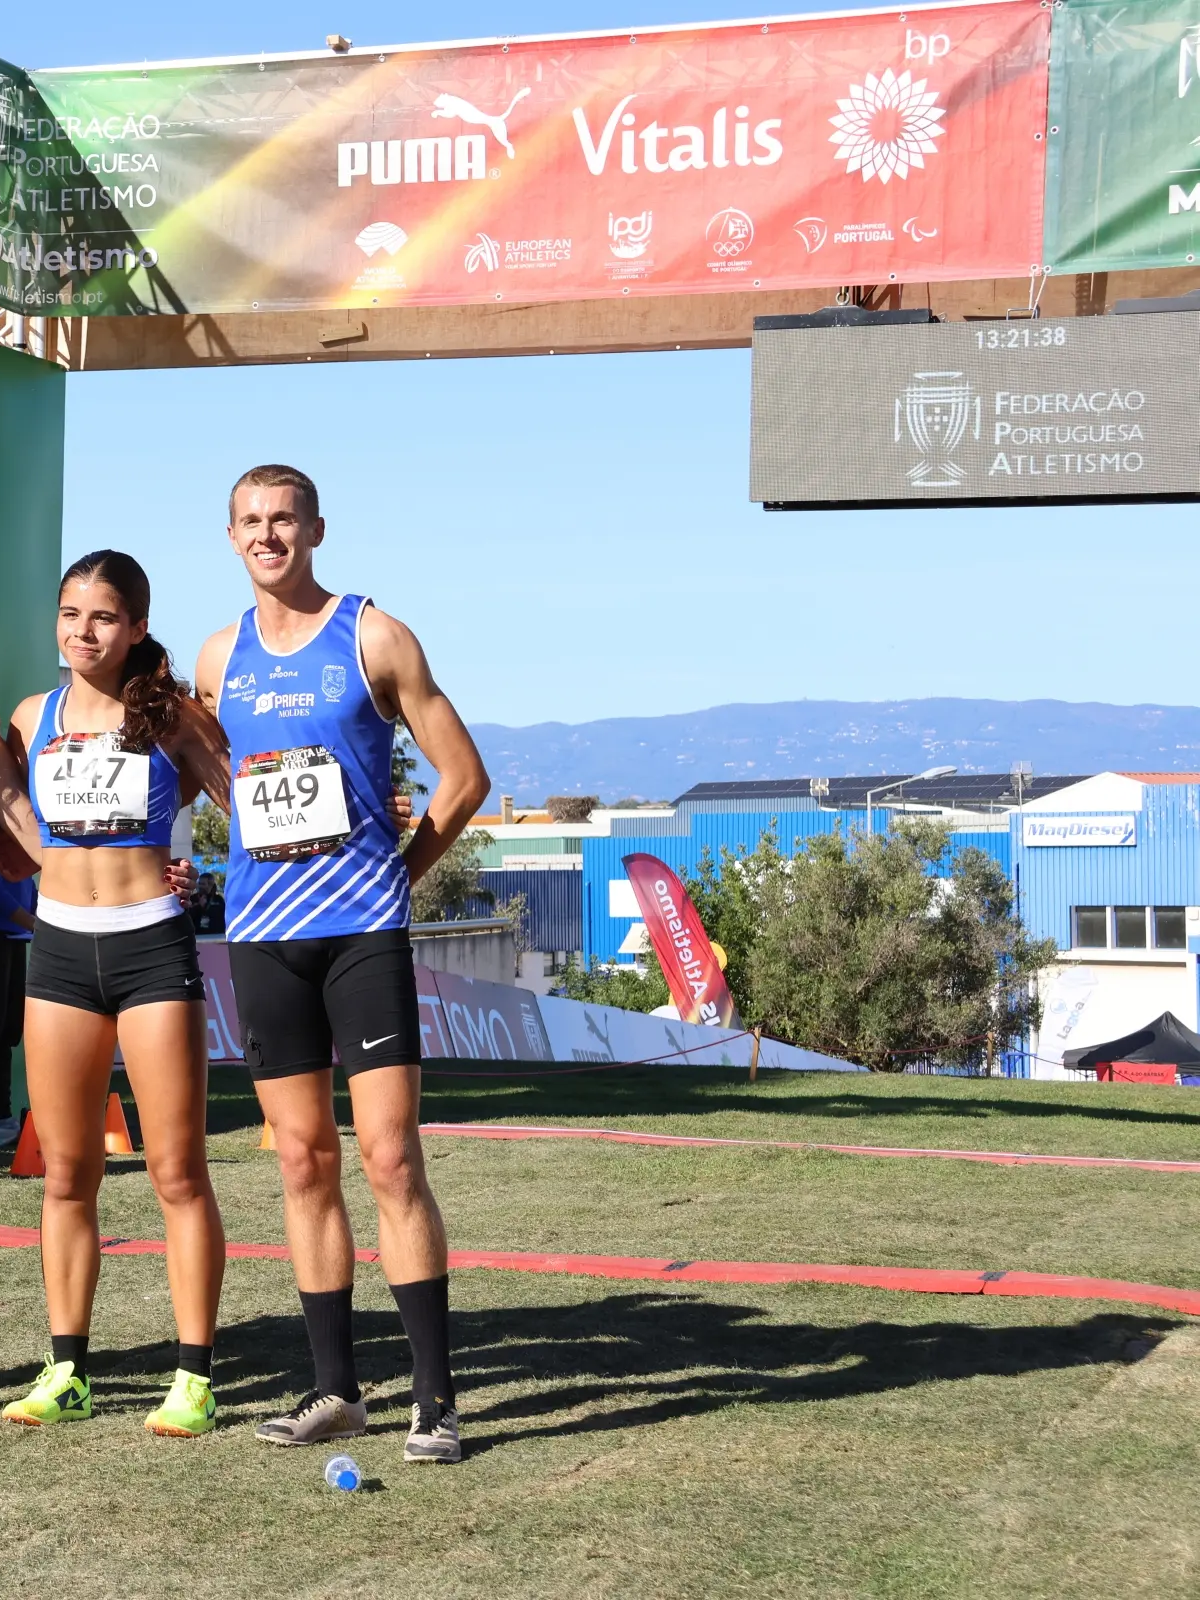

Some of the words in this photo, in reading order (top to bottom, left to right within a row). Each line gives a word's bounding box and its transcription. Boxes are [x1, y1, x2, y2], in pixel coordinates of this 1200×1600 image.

[904, 28, 951, 65] bp
[572, 94, 783, 177] Vitalis
[13, 147, 159, 177] PORTUGUESA
[338, 135, 486, 187] PUMA
[11, 183, 157, 212] ATLETISMO
[608, 211, 652, 242] ipdj
[834, 230, 895, 244] PORTUGAL
[504, 250, 571, 263] ATHLETICS
[505, 239, 572, 252] EUROPEAN
[974, 326, 1067, 350] 13:21:38
[995, 387, 1145, 416] FEDERAÇÃO
[994, 421, 1144, 446] PORTUGUESA
[988, 451, 1144, 476] ATLETISMO
[275, 693, 315, 708] PRIFER
[278, 708, 310, 719] MOLDES
[280, 758, 309, 772] MATO
[282, 748, 315, 762] CORTA
[55, 792, 121, 805] TEIXEIRA
[252, 773, 319, 813] 449
[268, 812, 307, 828] SILVA
[1027, 821, 1132, 839] MaqDiesel
[1056, 1001, 1085, 1040] Lagoa
